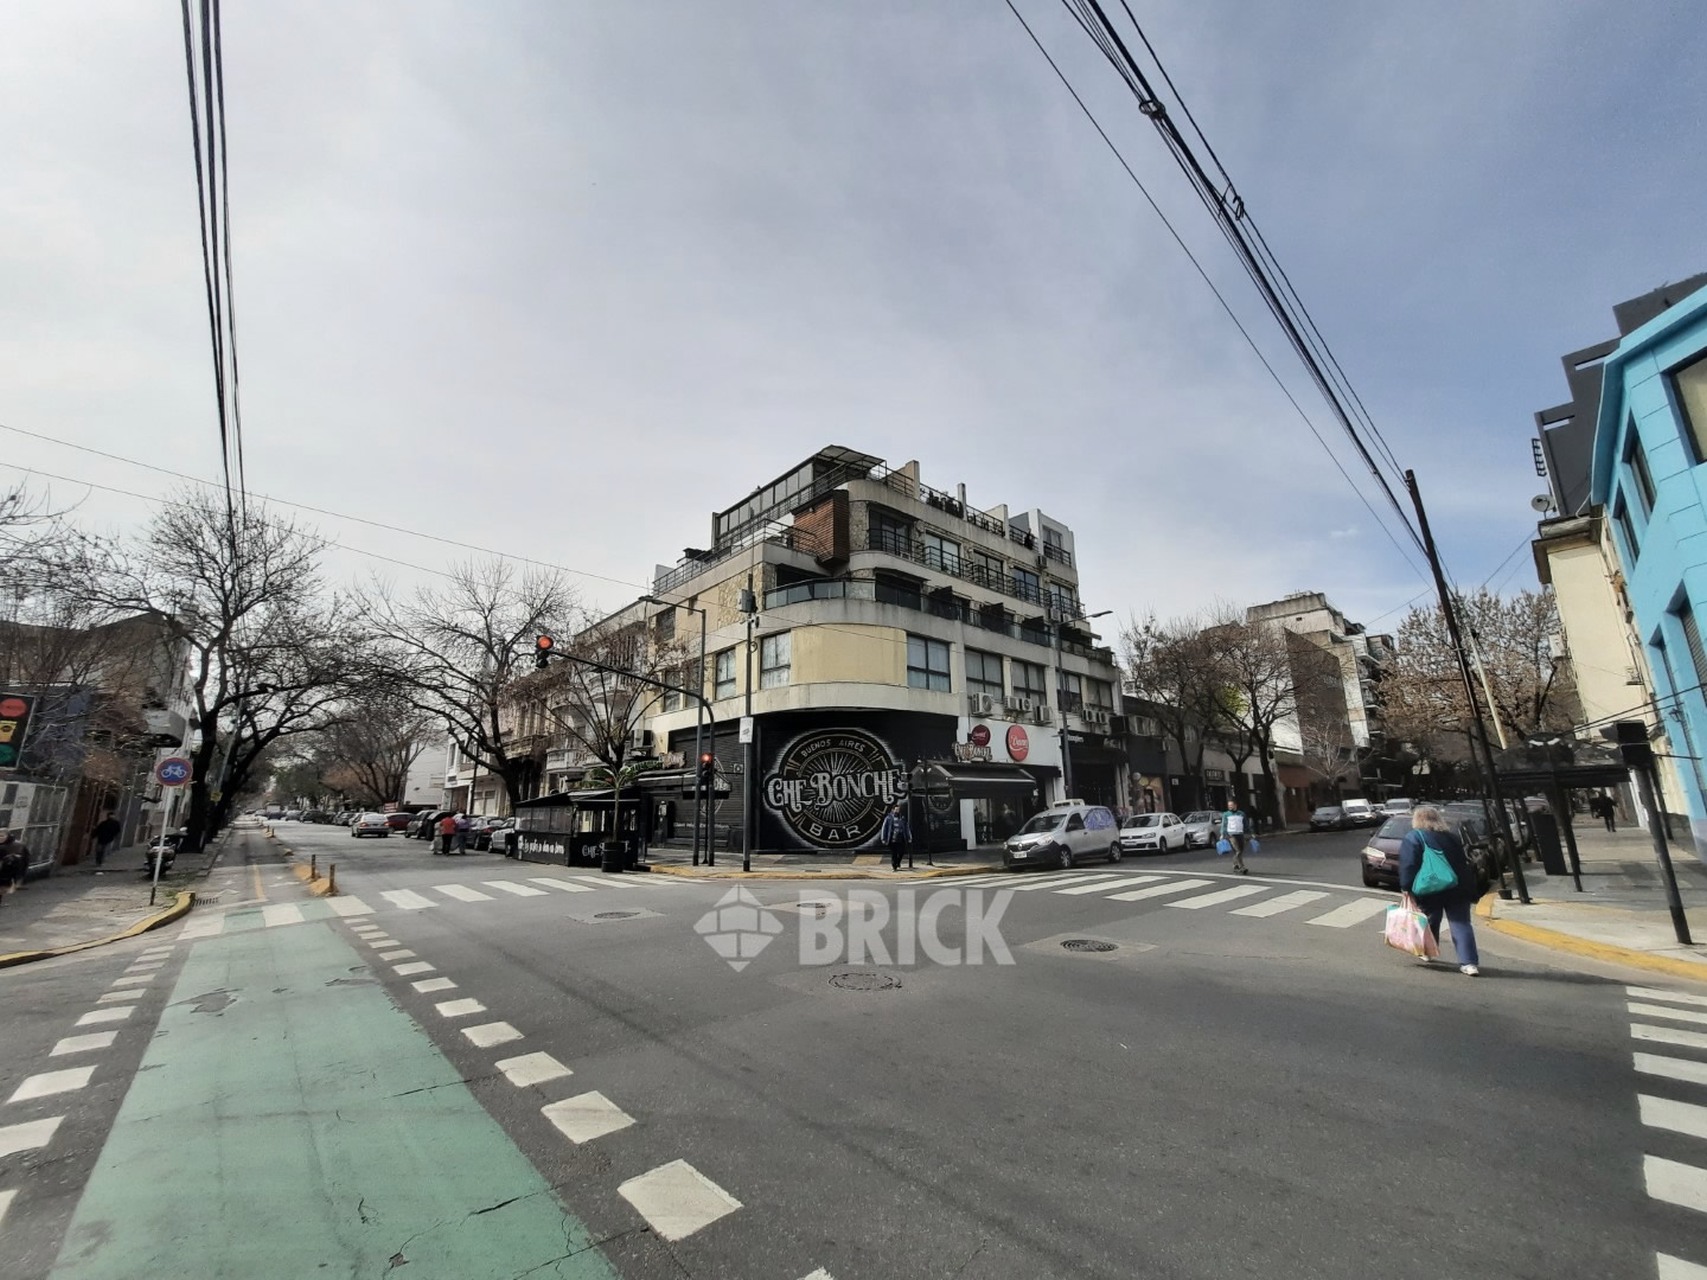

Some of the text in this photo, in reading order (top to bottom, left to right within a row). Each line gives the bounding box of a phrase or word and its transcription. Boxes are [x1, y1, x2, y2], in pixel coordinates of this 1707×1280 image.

[800, 739, 866, 758] BUENOS AIRES
[767, 778, 813, 813] CHE
[810, 768, 906, 811] BONCHE
[809, 823, 861, 840] BAR
